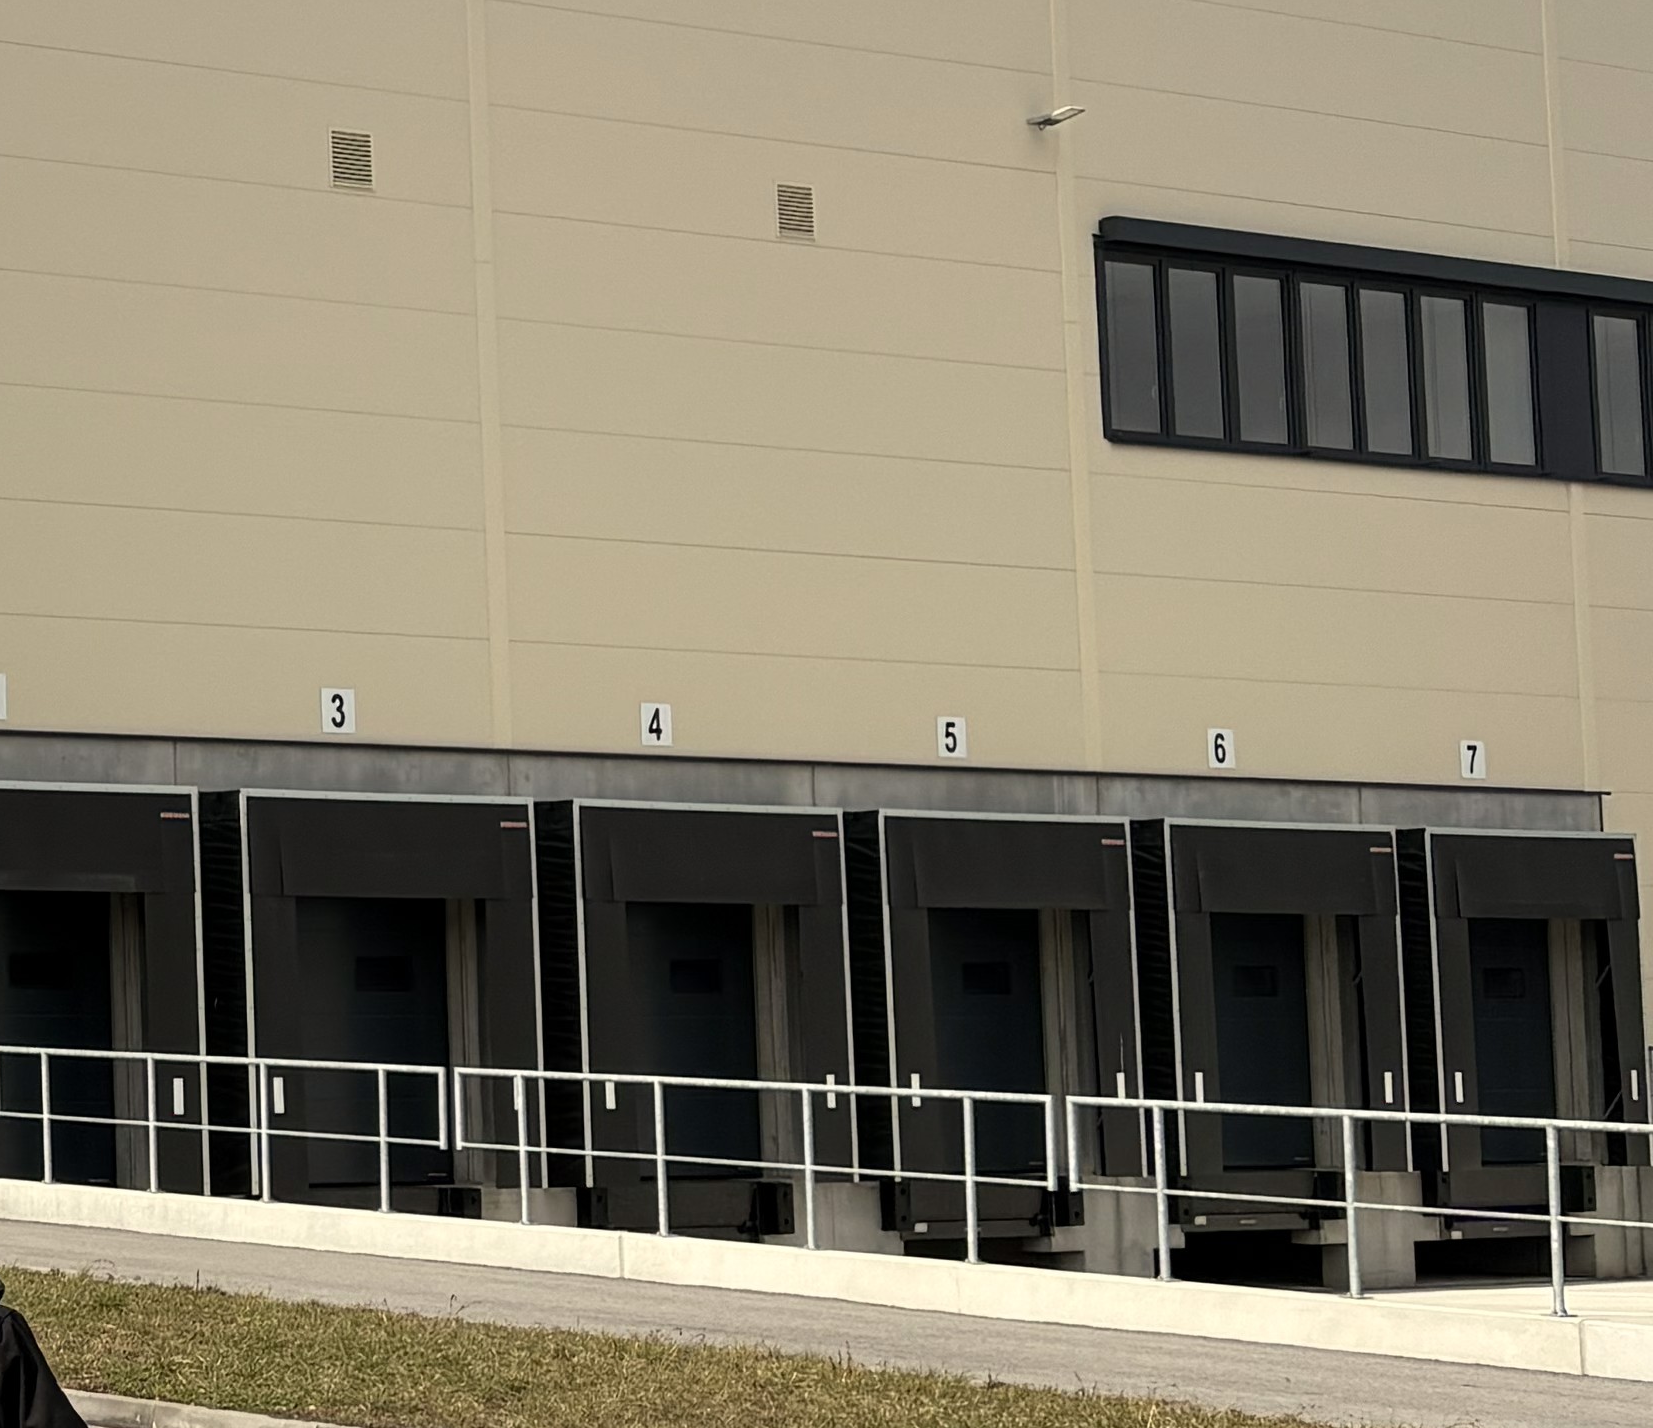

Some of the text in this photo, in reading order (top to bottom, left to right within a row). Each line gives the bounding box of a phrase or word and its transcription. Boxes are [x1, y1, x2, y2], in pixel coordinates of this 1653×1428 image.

[331, 693, 346, 728] 3
[648, 707, 663, 741] 4
[944, 721, 958, 754] 5
[1213, 733, 1227, 764] 6
[1466, 744, 1479, 775] 7
